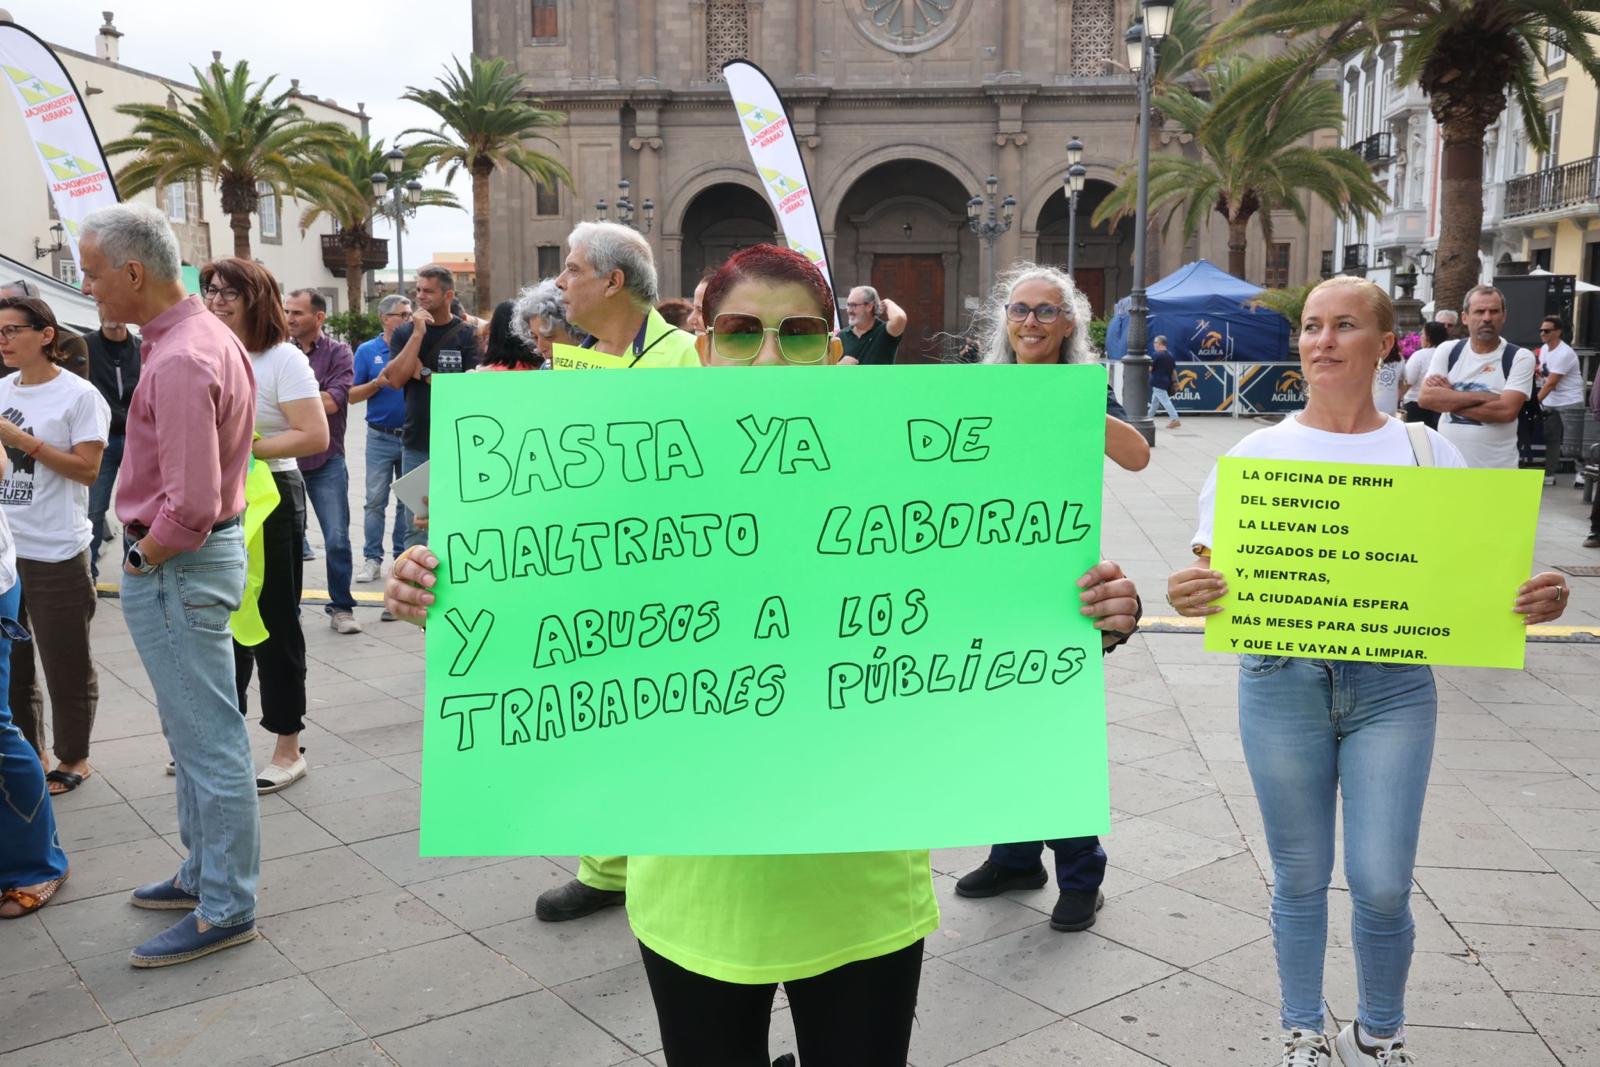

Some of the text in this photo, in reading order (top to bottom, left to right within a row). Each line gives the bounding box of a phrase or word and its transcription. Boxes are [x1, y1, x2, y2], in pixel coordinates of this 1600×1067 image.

[455, 414, 992, 502] BASTA YA DE
[11, 480, 34, 490] LUCHA
[1242, 470, 1394, 488] LA OFICINA DE RRHH
[1240, 495, 1341, 511] DEL SERVICIO
[1238, 519, 1350, 535] LA LLEVAN LOS
[448, 499, 1091, 584] MALTRATO LABORAL
[1236, 544, 1419, 564] JUZGADOS DE LO SOCIAL
[1235, 567, 1330, 585] Y, MIENTRAS,
[1237, 591, 1409, 611] LA CIUDADANÍA ESPERA
[444, 589, 928, 676] Y ABUSOS A LOS
[1231, 613, 1451, 637] MÁS MESES PARA SUS JUICIOS
[1230, 638, 1428, 660] Y QUE LE VAYAN A LIMPIAR.
[440, 664, 786, 751] TRABADORES
